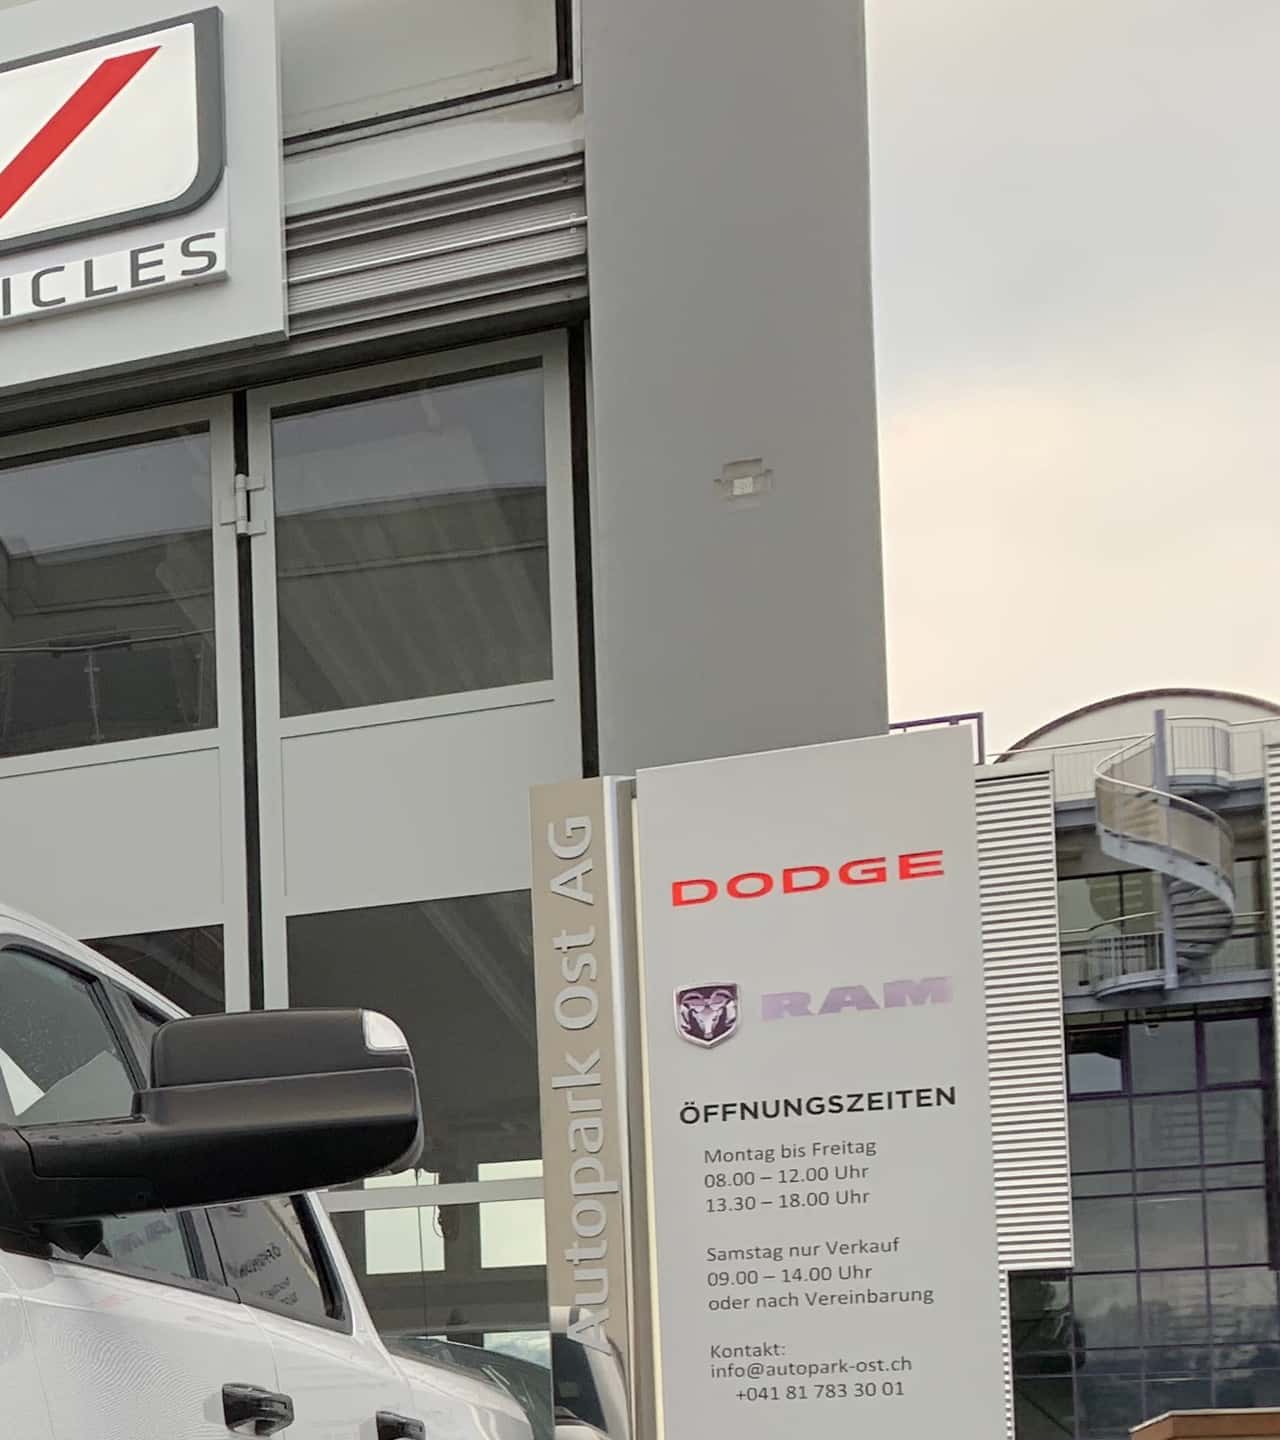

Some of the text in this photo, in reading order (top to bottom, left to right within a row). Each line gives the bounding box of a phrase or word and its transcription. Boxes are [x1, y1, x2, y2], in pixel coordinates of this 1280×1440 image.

[671, 849, 945, 907] DODGE
[760, 975, 953, 1022] RAM
[547, 815, 619, 1356] Autopark Ost AG
[679, 1086, 956, 1124] ÖFFNUNGSZEITEN
[704, 1140, 877, 1164] Montag bis Freitag
[704, 1171, 755, 1188] 08.00
[778, 1166, 829, 1184] 12.00
[834, 1164, 869, 1181] Uhr
[706, 1195, 756, 1213] 13.30
[778, 1191, 830, 1209] 18.00
[835, 1188, 870, 1206] Uhr
[706, 1237, 900, 1262] Samstag nur Verkauf
[707, 1270, 758, 1287] 09.00
[782, 1266, 833, 1283] 14.00
[838, 1264, 873, 1280] Uhr
[708, 1288, 935, 1311] oder nach Vereinbarung
[710, 1342, 786, 1359] Kontakt:
[711, 1356, 913, 1379] info@autopark-ost.ch
[736, 1381, 905, 1401] +041 81 783 30 01
